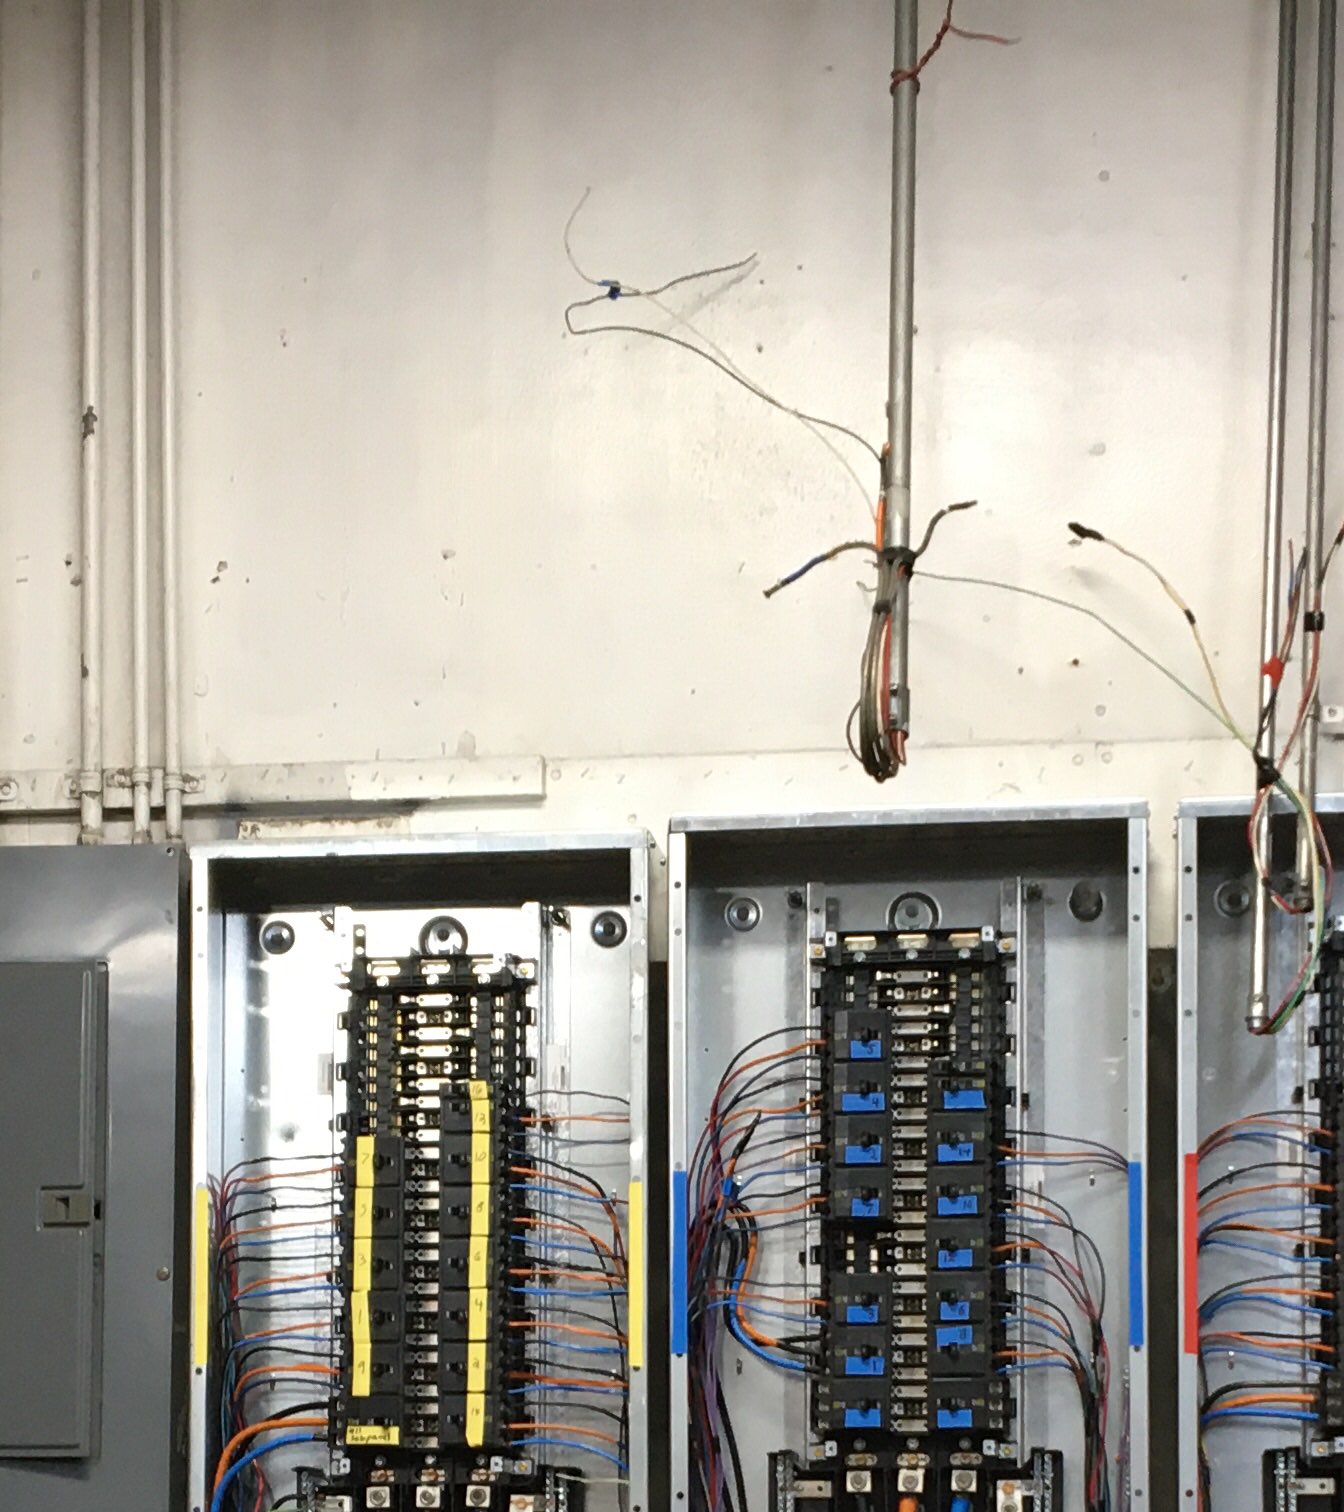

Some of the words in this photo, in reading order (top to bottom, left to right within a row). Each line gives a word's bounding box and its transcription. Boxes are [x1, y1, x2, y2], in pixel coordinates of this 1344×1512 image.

[867, 1096, 877, 1109] 4
[474, 1112, 486, 1126] 13
[360, 1152, 370, 1165] 7
[474, 1151, 487, 1162] 10
[476, 1200, 485, 1214] 8
[359, 1252, 368, 1266] 3
[473, 1250, 481, 1262] 6
[474, 1297, 484, 1313] 4
[357, 1308, 363, 1325] 1
[357, 1359, 366, 1375] 9
